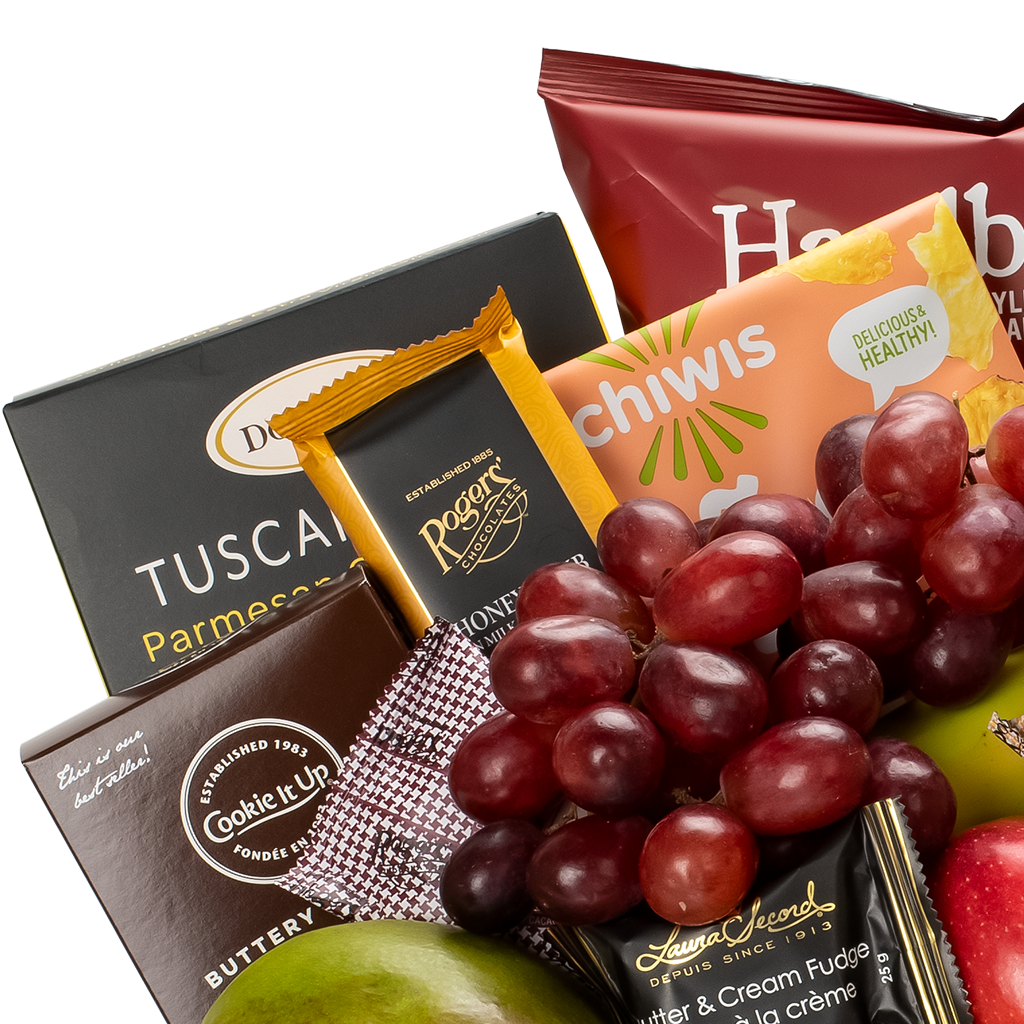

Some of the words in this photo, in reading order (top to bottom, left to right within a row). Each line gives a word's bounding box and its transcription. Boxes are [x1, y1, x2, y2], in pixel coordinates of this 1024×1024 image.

[857, 318, 939, 372] HEALTHY!
[405, 461, 472, 503] ESTABLISHED
[471, 447, 494, 465] 1885
[461, 483, 521, 569] CHOCOLATES
[135, 507, 347, 607] TUSCA
[142, 576, 331, 662] Parmes
[96, 747, 111, 765] is
[200, 739, 269, 804] ESTABLISHED
[273, 739, 309, 758] 1983
[74, 772, 110, 809] best
[203, 793, 278, 843] Cookie
[276, 784, 298, 805] It
[232, 843, 289, 862] FONDÉE
[290, 836, 309, 854] EN
[204, 906, 314, 991] BUTTERY
[636, 925, 724, 972] Laura
[722, 880, 836, 947] Second
[649, 961, 713, 988] DEPUIS
[722, 939, 776, 964] SINCE
[785, 921, 833, 944] 1913
[697, 995, 717, 1017] &
[718, 969, 803, 1008] Cream
[805, 942, 870, 980] Fudge
[877, 953, 889, 963] g
[878, 965, 894, 984] 25
[786, 982, 858, 1020] crème
